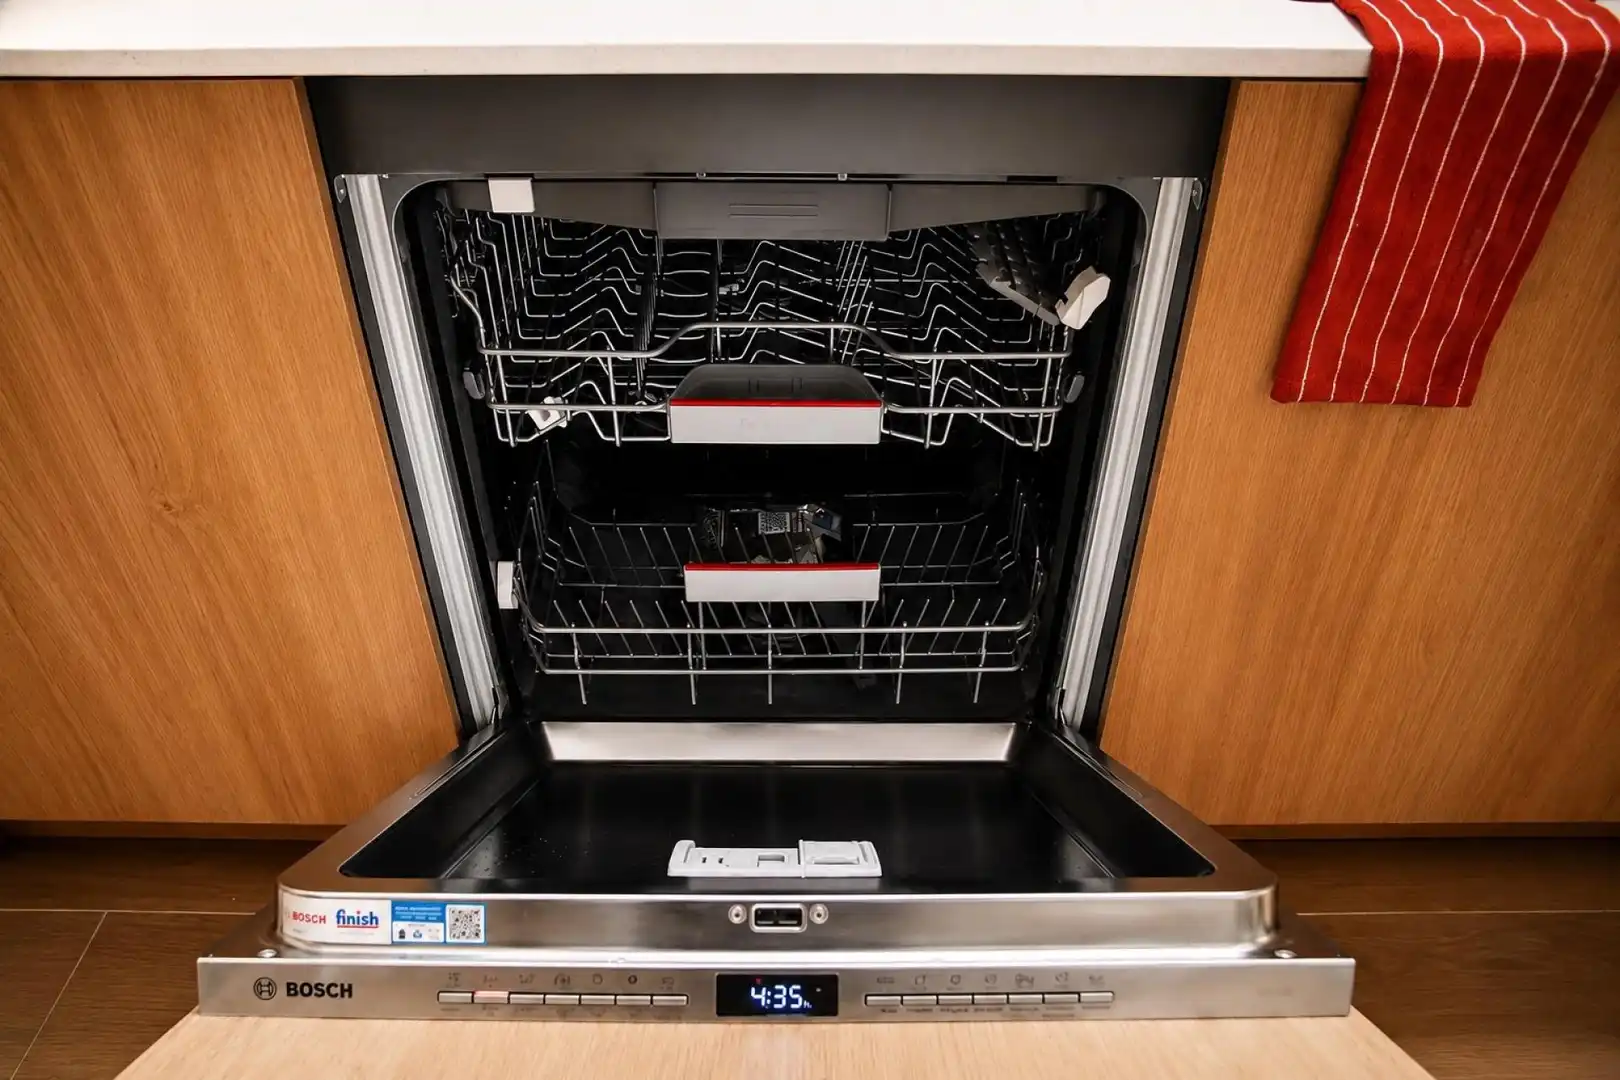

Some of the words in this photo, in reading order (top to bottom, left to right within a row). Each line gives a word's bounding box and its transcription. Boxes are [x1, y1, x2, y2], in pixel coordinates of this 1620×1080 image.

[292, 910, 327, 925] BOSCH
[336, 909, 379, 926] finish
[286, 982, 353, 998] BOSCH
